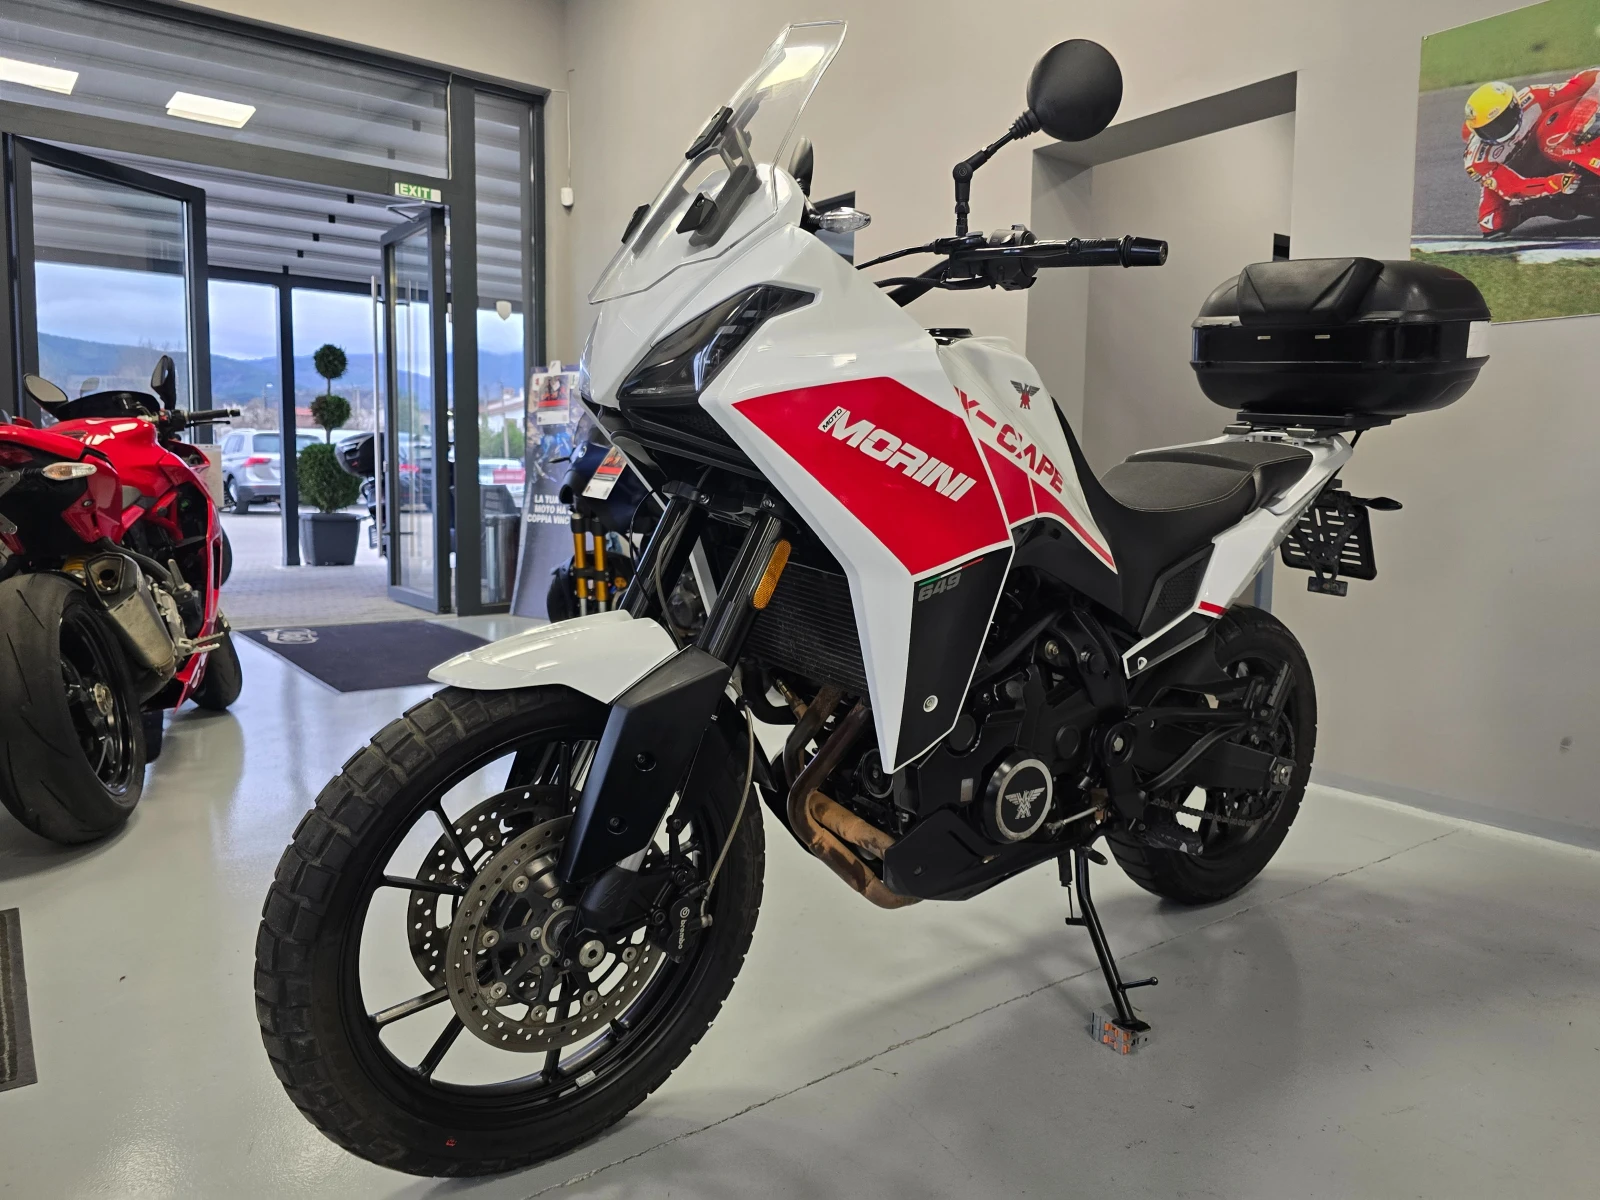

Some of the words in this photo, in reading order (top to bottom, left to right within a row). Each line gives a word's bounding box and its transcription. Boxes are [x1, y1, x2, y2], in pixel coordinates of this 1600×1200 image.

[400, 183, 430, 199] EXIT
[822, 408, 843, 430] MOTO
[831, 410, 977, 502] MORINI
[534, 494, 544, 503] LA
[545, 495, 559, 504] TUA
[527, 514, 552, 523] COPPIA
[534, 504, 555, 513] MOTO
[556, 505, 566, 514] HA
[917, 572, 962, 602] 649
[678, 919, 686, 949] brembo
